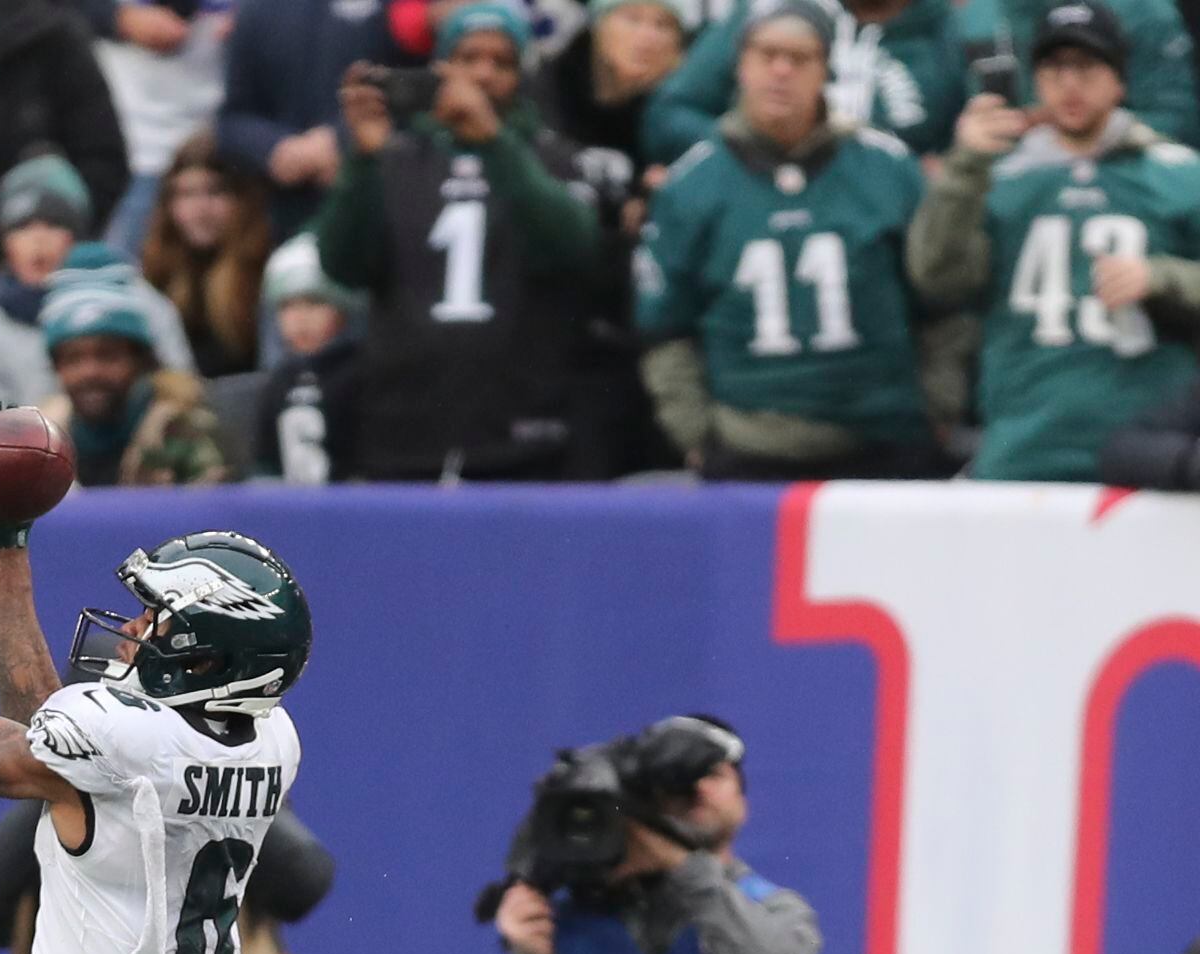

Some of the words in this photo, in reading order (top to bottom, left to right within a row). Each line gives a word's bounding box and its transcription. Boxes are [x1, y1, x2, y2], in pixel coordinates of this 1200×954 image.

[428, 199, 494, 322] 1
[732, 232, 863, 357] 11
[177, 765, 282, 818] SMITH
